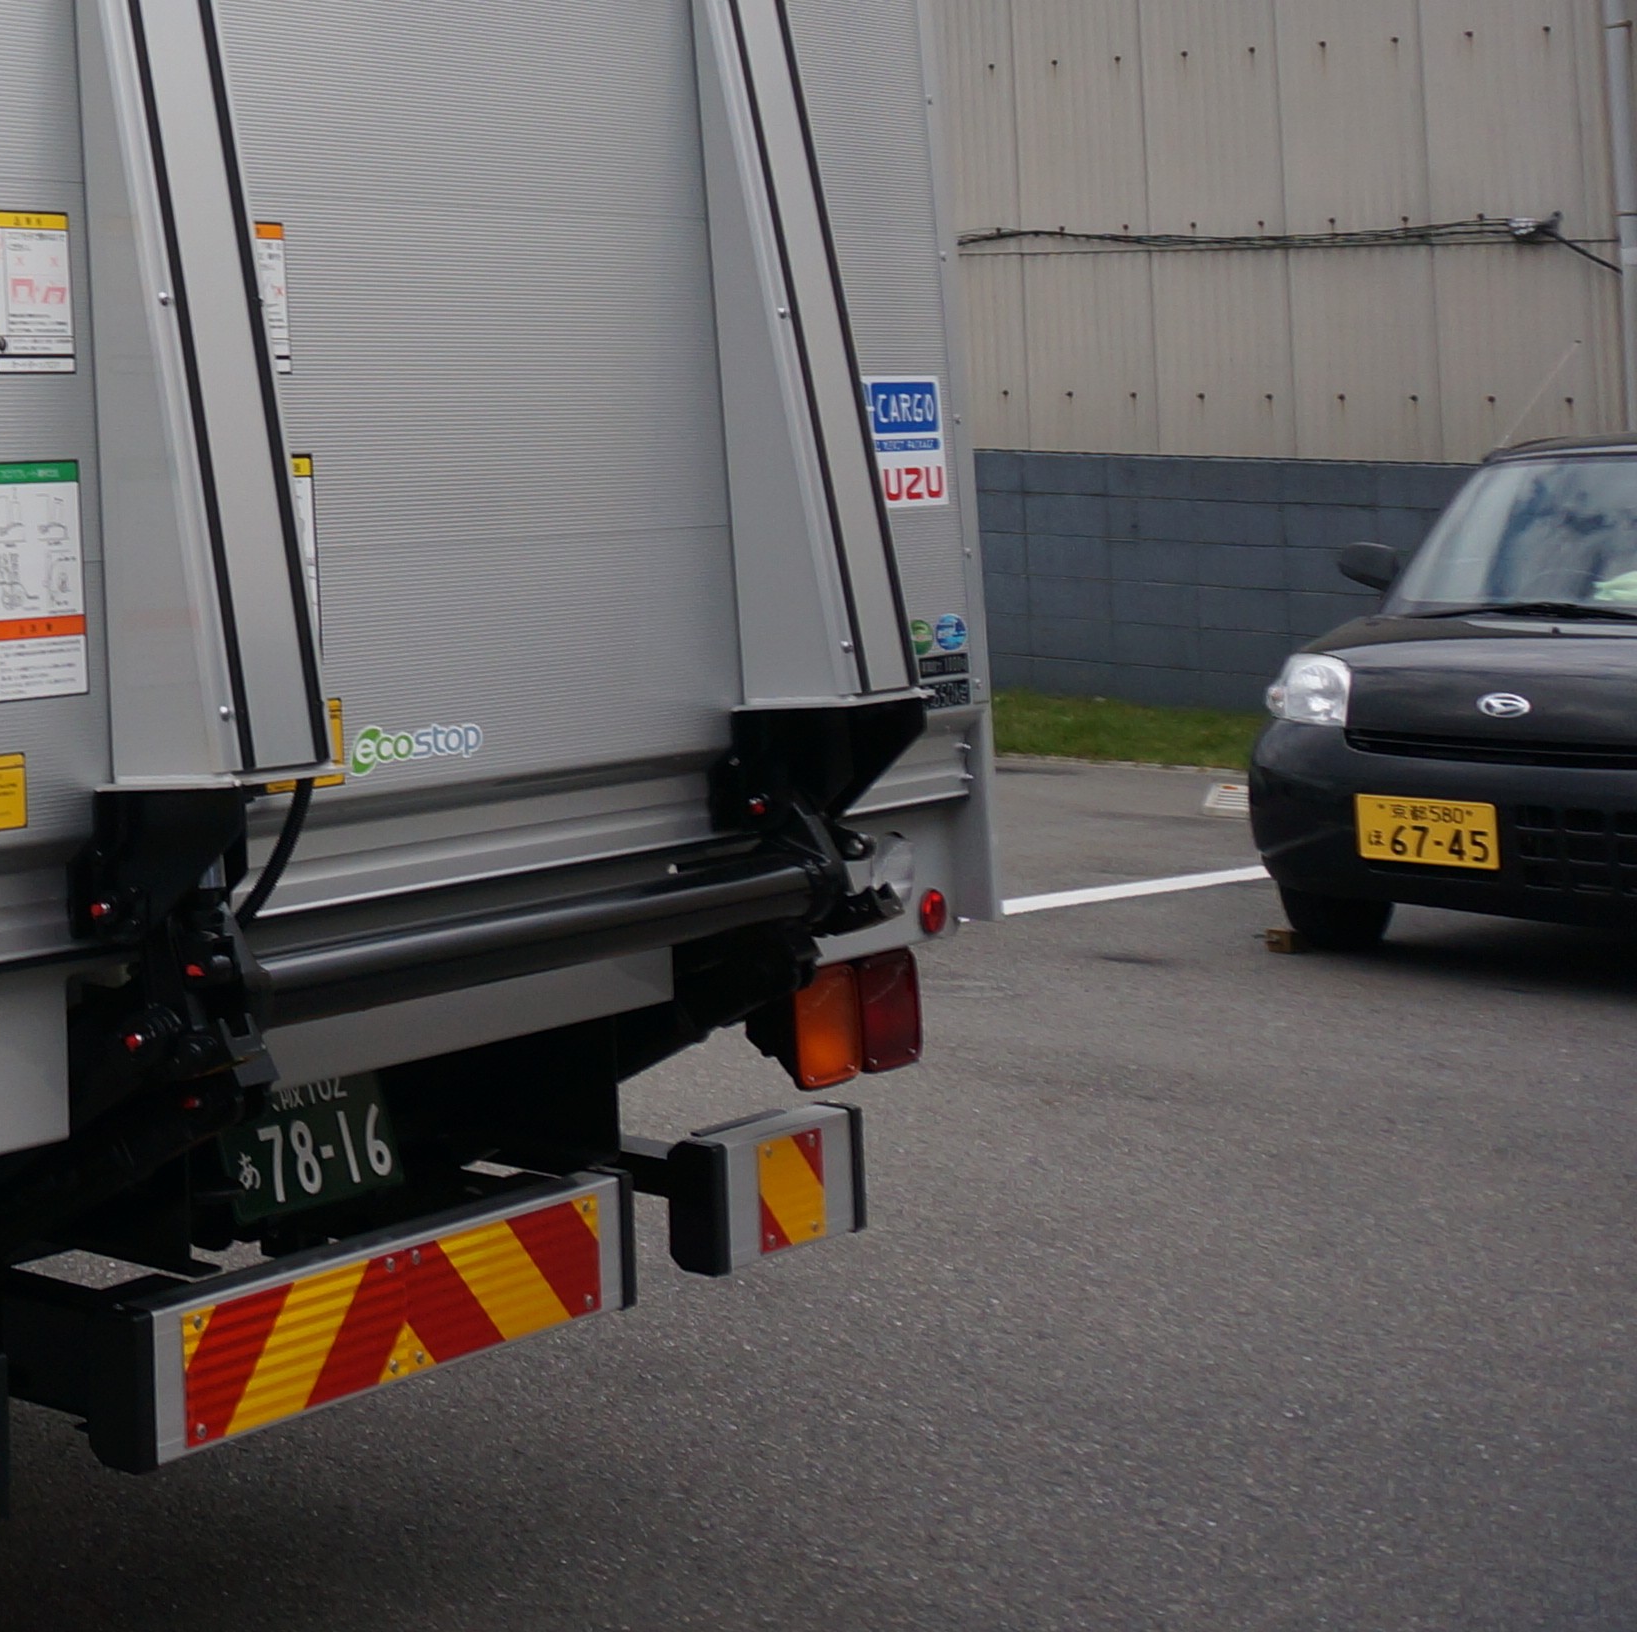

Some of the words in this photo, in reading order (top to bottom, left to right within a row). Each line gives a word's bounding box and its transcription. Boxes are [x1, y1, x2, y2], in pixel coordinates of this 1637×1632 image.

[883, 466, 944, 501] UZU
[356, 725, 482, 763] ecostop
[1390, 824, 1491, 863] 67-45
[238, 1152, 261, 1191] あ
[256, 1103, 393, 1204] 78-16
